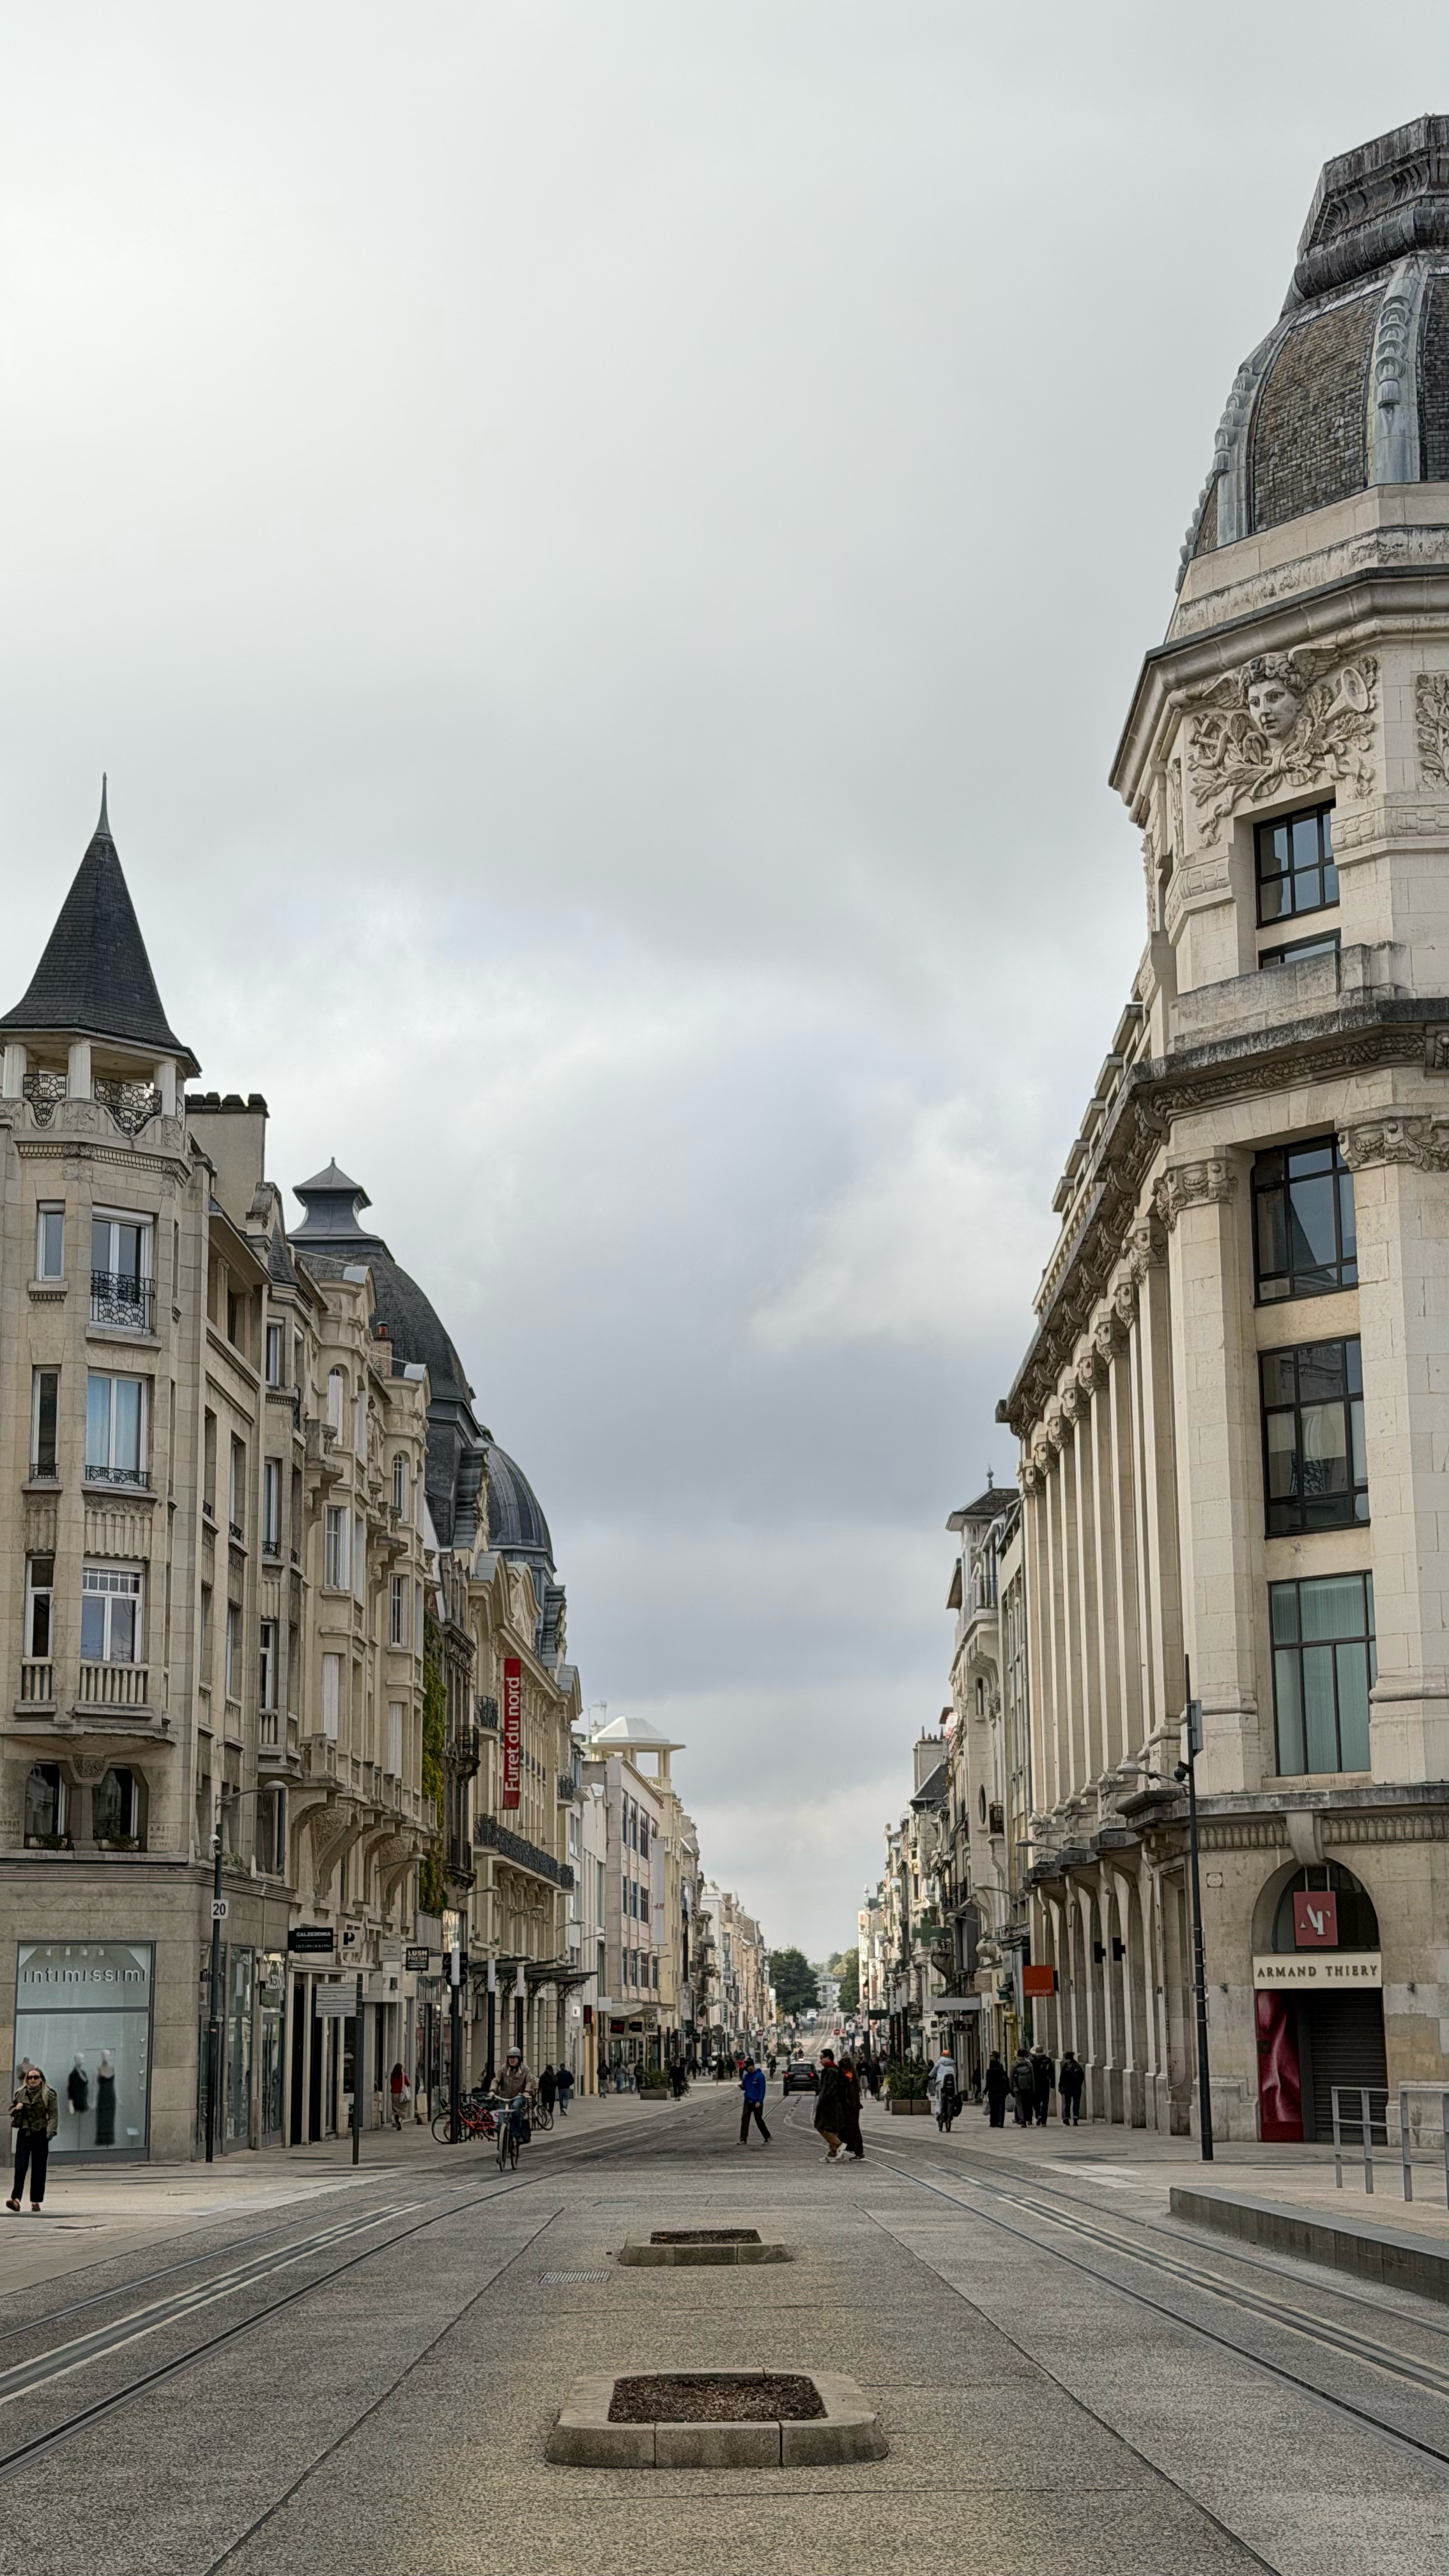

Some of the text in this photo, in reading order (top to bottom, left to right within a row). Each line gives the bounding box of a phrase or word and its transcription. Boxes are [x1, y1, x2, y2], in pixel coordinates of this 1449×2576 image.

[505, 1677, 519, 1791] Furet du nord
[213, 1903, 226, 1916] 20
[24, 1967, 147, 1983] intimissimi
[1257, 1965, 1377, 1977] ARMAND THIERY
